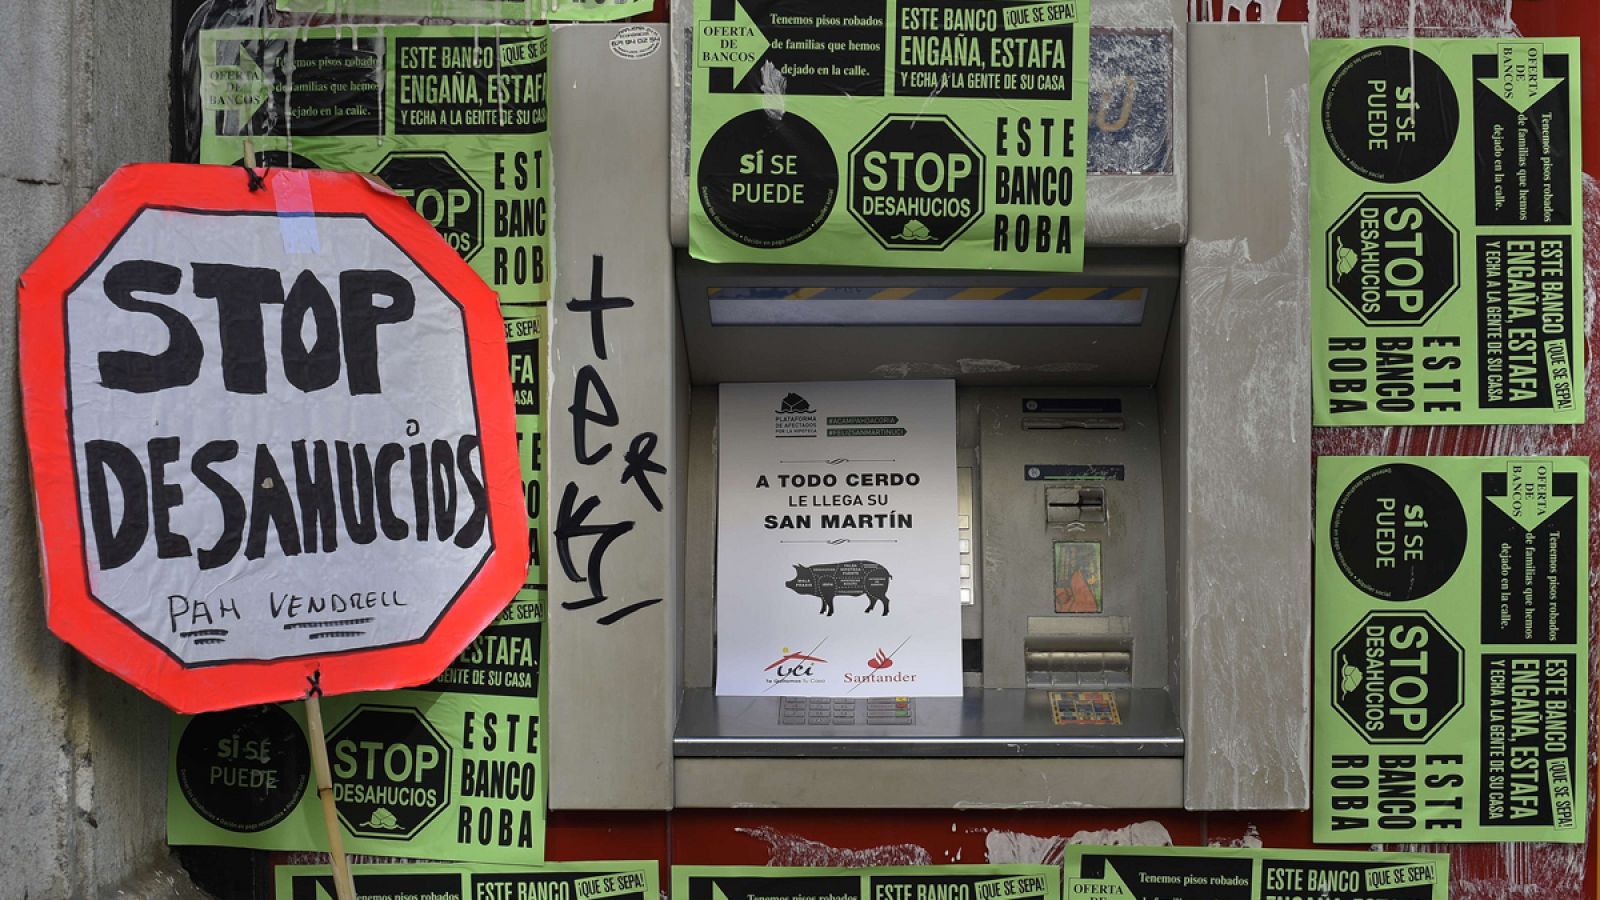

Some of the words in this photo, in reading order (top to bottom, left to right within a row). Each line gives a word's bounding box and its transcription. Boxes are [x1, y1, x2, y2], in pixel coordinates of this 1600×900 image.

[770, 13, 814, 26] Tenemos
[815, 15, 840, 30] pisos
[842, 15, 884, 28] robados
[901, 8, 940, 32] ESTE
[944, 8, 997, 33] BANCO
[1006, 9, 1029, 26] ¡QUE
[1031, 7, 1043, 22] SE
[1046, 4, 1075, 20] SEPA!
[703, 26, 755, 37] OFERTA
[720, 38, 737, 50] DE
[400, 46, 437, 69] ESTE
[442, 46, 494, 69] BANCO
[702, 51, 756, 63] BANCOS
[771, 38, 785, 50] de
[787, 39, 825, 51] familias
[827, 42, 846, 54] que
[848, 39, 881, 52] hemos
[901, 31, 986, 71] ENGAÑA,
[990, 37, 1066, 69] ESTAFA
[781, 64, 814, 78] dejado
[816, 67, 828, 76] en
[830, 64, 840, 76] la
[842, 65, 870, 77] calle.
[901, 72, 908, 87] Y
[910, 72, 938, 88] ECHA
[940, 73, 949, 88] A
[951, 73, 965, 89] LA
[967, 73, 1001, 89] GENTE
[1003, 73, 1017, 90] DE
[1020, 74, 1035, 90] SU
[1037, 74, 1065, 91] CASA
[1502, 47, 1514, 99] BANCOS
[1516, 64, 1526, 81] DE
[1527, 47, 1538, 98] OFERTA
[400, 72, 483, 107] ENGAÑA,
[1395, 86, 1420, 110] SÍ
[410, 109, 437, 125] ECHA
[451, 109, 463, 125] LA
[465, 109, 499, 125] GENTE
[516, 109, 530, 125] SU
[1367, 79, 1388, 150] PUEDE
[996, 116, 1075, 158] ESTE
[1396, 115, 1415, 143] SE
[1541, 111, 1553, 154] Tenemos
[739, 149, 765, 174] SÍ
[770, 155, 798, 175] SE
[862, 151, 972, 193] STOP
[1540, 156, 1553, 181] pisos
[732, 183, 805, 204] PUEDE
[995, 165, 1073, 207] BANCO
[862, 196, 971, 218] DESAHUCIOS
[1543, 183, 1554, 222] robados
[993, 213, 1072, 254] ROBA
[1359, 207, 1381, 314] DESAHUCIOS
[1383, 207, 1424, 313] STOP
[1486, 251, 1501, 278] ECHA
[1541, 240, 1563, 277] ESTE
[1504, 240, 1540, 324] ENGAÑA,
[1486, 291, 1501, 304] LA
[1541, 281, 1564, 334] BANCO
[98, 260, 416, 396] STOP
[1486, 306, 1502, 339] GENTE
[1487, 342, 1502, 355] DE
[1328, 336, 1368, 414] ROBA
[1375, 336, 1415, 413] BANCO
[1422, 336, 1461, 413] ESTE
[1487, 358, 1503, 372] SU
[1508, 328, 1537, 402] ESTAFA
[1552, 367, 1569, 380] SE
[1487, 375, 1503, 402] CASA
[1554, 382, 1572, 410] SEPA!
[756, 475, 770, 489] A
[778, 474, 837, 488] TODO
[846, 473, 921, 487] CERDO
[1512, 466, 1522, 517] BANCOS
[1525, 483, 1534, 500] DE
[1536, 465, 1547, 516] OFERTA
[788, 496, 808, 507] LE
[813, 495, 863, 507] LLEGA
[868, 494, 889, 506] SU
[764, 515, 811, 529] SAN
[821, 510, 913, 529] MARTÍN
[1404, 504, 1429, 529] SÍ
[1376, 498, 1395, 569] PUEDE
[1525, 532, 1536, 545] de
[1404, 535, 1424, 561] SE
[1549, 531, 1560, 573] Tenemos
[1525, 547, 1536, 585] familias
[1522, 587, 1533, 606] que
[1546, 575, 1560, 600] pisos
[269, 588, 408, 618] VENDRELL
[1525, 608, 1536, 640] hemos
[1549, 602, 1560, 641] robados
[505, 671, 532, 688] CASA
[844, 671, 917, 684] Santander
[1365, 626, 1384, 732] DESAHUCIOS
[1389, 625, 1429, 732] STOP
[1490, 669, 1506, 696] ECHA
[1545, 659, 1568, 696] ESTE
[1508, 659, 1543, 742] ENGAÑA,
[1490, 709, 1505, 722] LA
[1544, 700, 1568, 752] BANCO
[217, 734, 240, 758] SÍ
[463, 711, 540, 754] ESTE
[1490, 724, 1505, 757] GENTE
[334, 740, 439, 783] STOP
[1490, 760, 1505, 773] DE
[210, 766, 278, 789] PUEDE
[460, 758, 536, 802] BANCO
[1489, 776, 1504, 789] SU
[1510, 746, 1539, 820] ESTAFA
[333, 783, 437, 808] DESAHUCIOS
[1331, 755, 1370, 831] ROBA
[1377, 755, 1417, 830] BANCO
[1424, 754, 1464, 830] ESTE
[1554, 786, 1569, 798] SE
[1489, 792, 1504, 820] CASA
[1555, 800, 1573, 827] SEPA!
[457, 805, 533, 849] ROBA
[604, 876, 616, 892] SE
[618, 873, 645, 890] SEPA!
[1003, 880, 1016, 896] SE
[1018, 876, 1045, 894] SEPA!
[1073, 884, 1124, 895] OFERTA
[1139, 872, 1181, 884] Tenemos
[1183, 873, 1208, 887] pisos
[1209, 875, 1249, 886] robados
[1267, 868, 1303, 891] ESTE
[1308, 869, 1360, 893] BANCO
[1368, 869, 1391, 888] ¡QUE
[1393, 868, 1406, 883] SE
[1408, 865, 1435, 881] SEPA!
